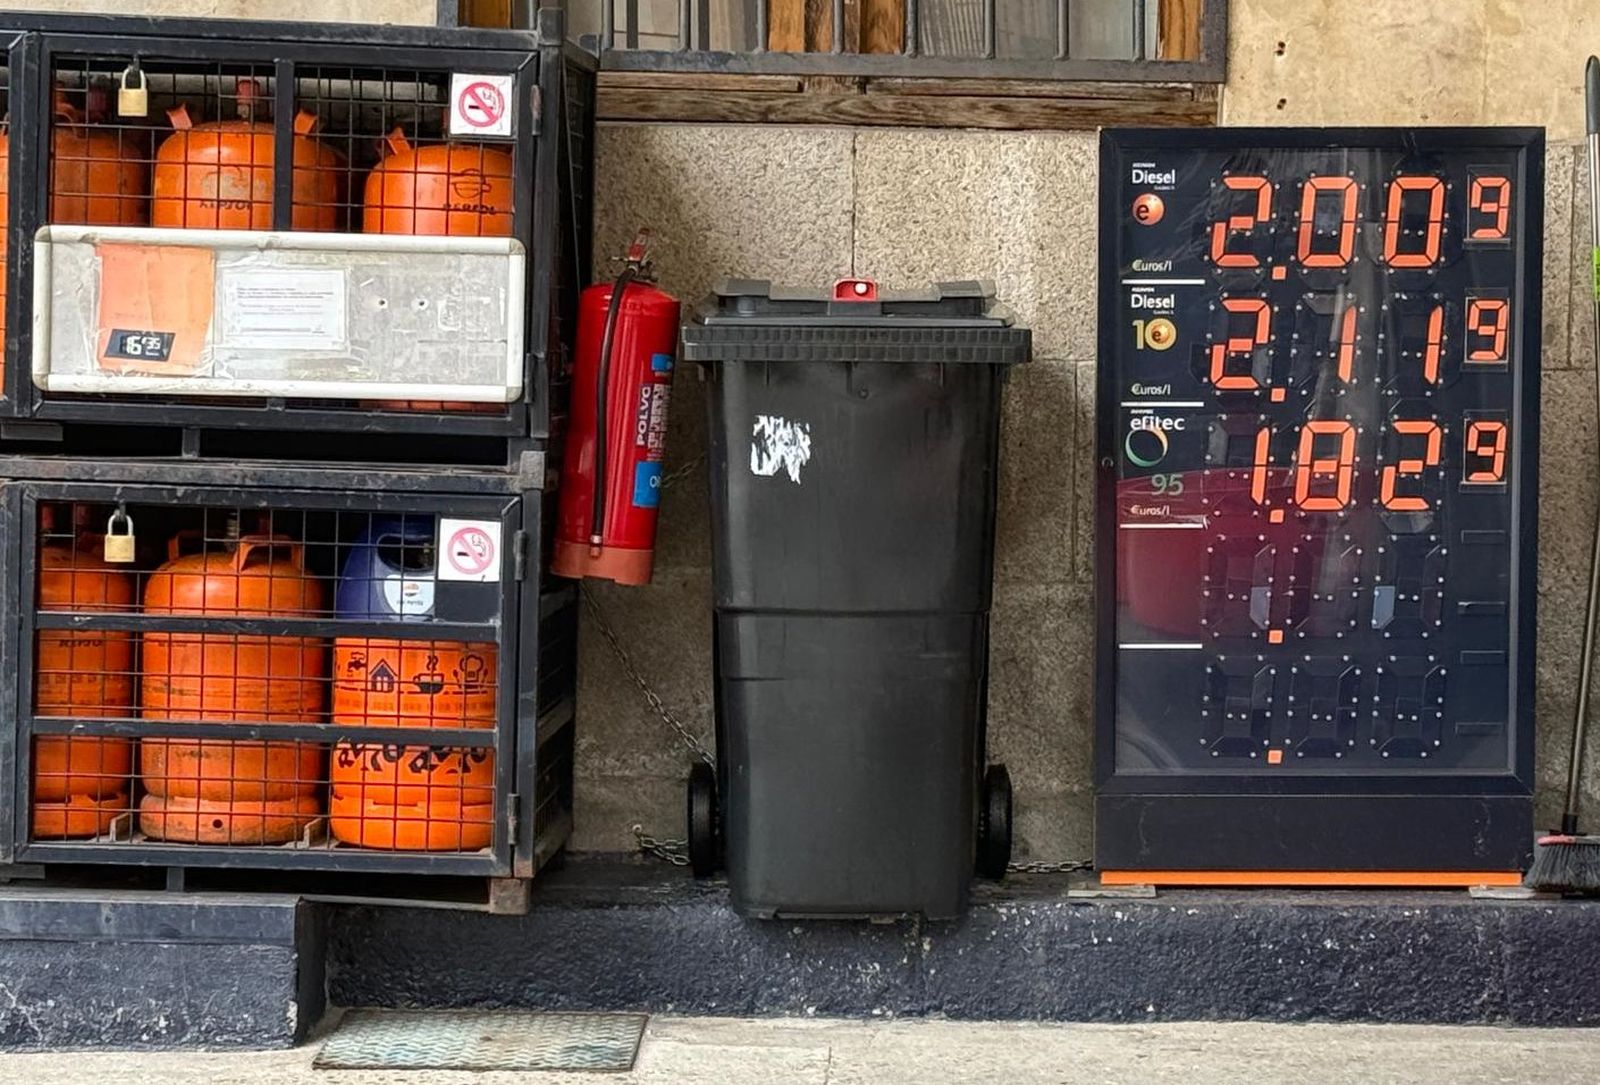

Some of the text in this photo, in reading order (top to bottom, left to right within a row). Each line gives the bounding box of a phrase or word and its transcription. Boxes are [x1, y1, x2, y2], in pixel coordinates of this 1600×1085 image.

[1131, 169, 1176, 184] Diesel
[1130, 293, 1175, 309] Diesel
[636, 386, 651, 446] POLVO
[1130, 416, 1185, 431] efitec
[1151, 474, 1184, 496] 95
